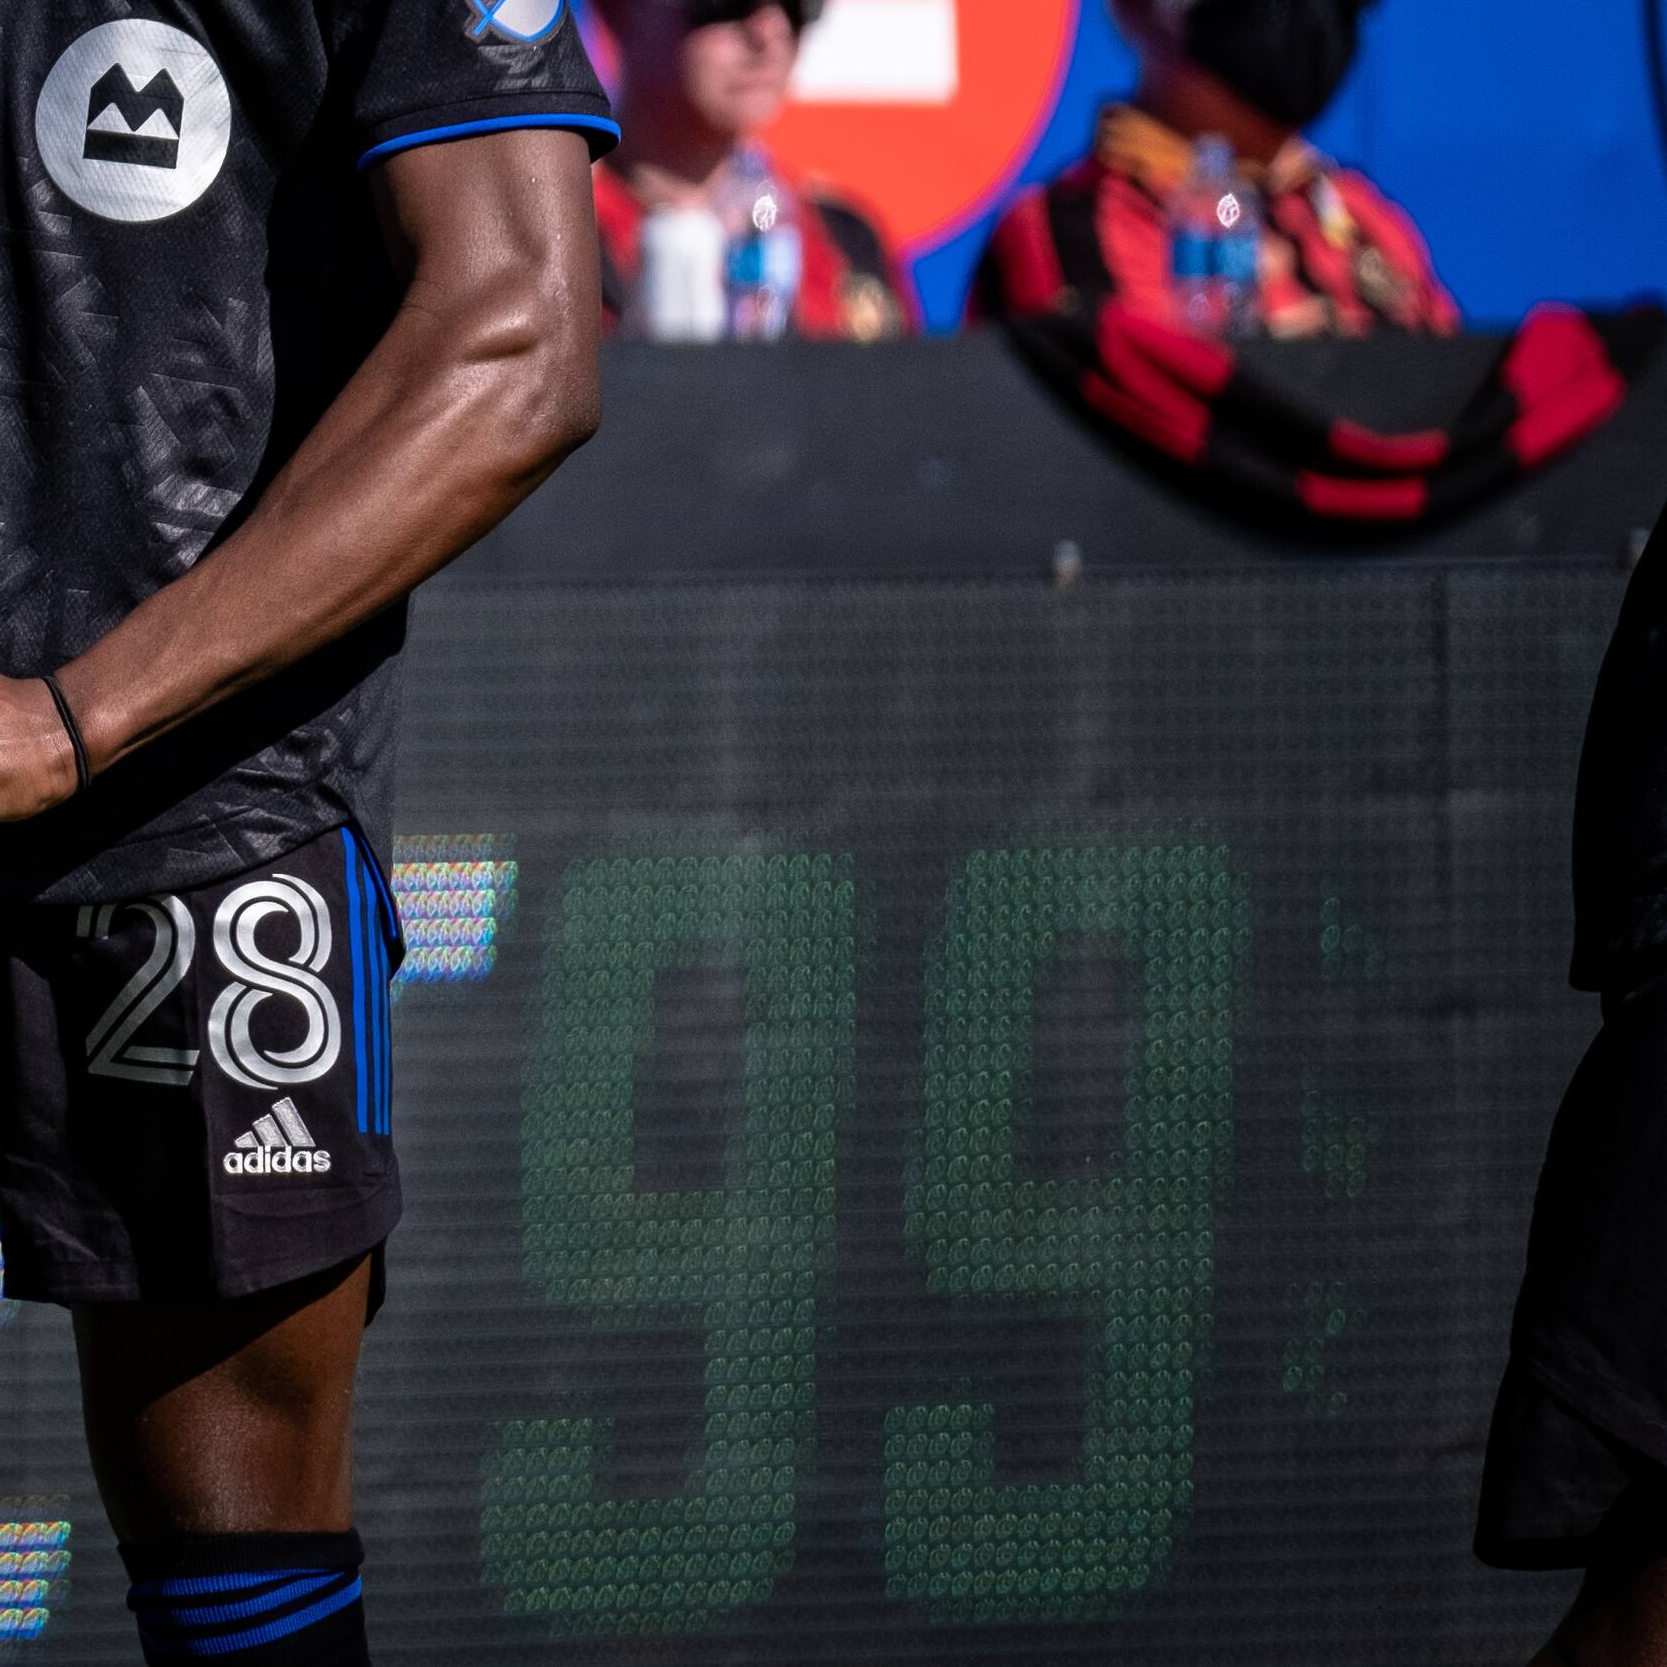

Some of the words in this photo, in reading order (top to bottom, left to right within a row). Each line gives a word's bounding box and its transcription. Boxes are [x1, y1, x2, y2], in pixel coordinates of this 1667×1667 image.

[76, 872, 342, 1091] 28
[222, 1145, 332, 1174] adidas
[479, 834, 1245, 1626] 99
